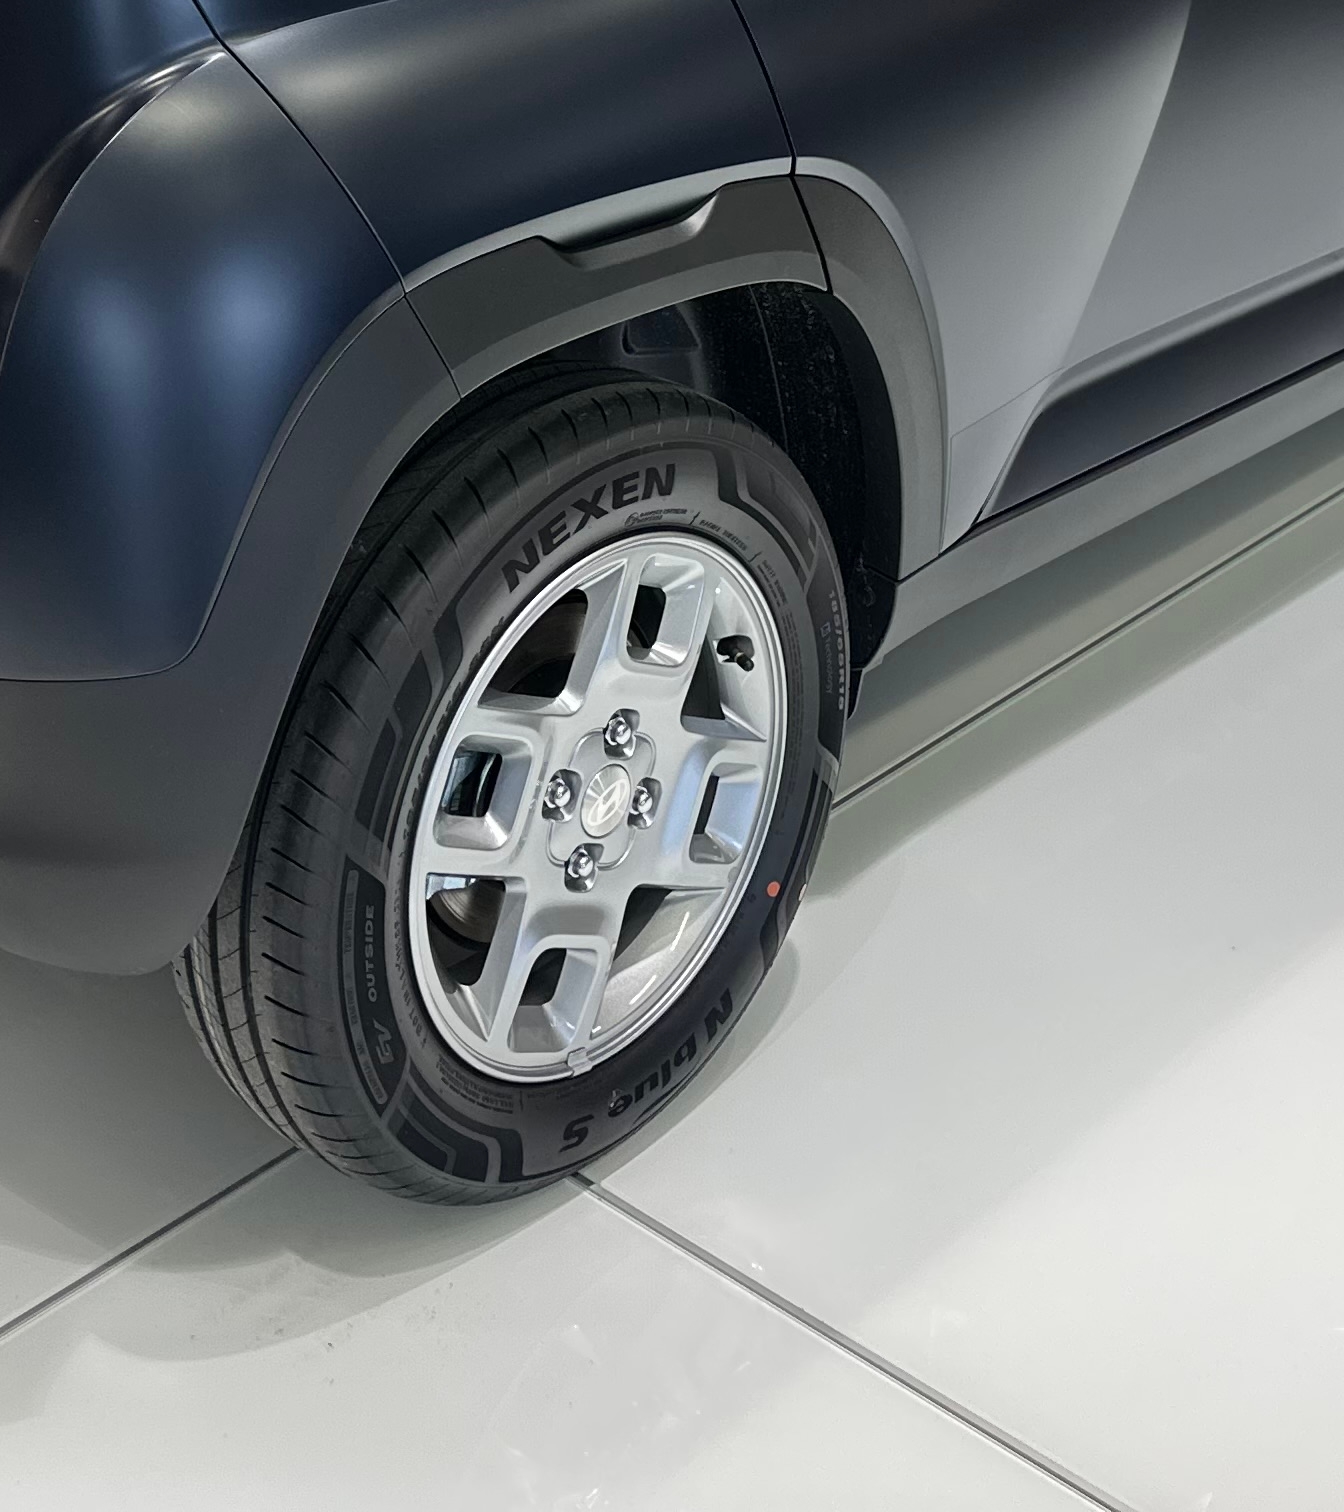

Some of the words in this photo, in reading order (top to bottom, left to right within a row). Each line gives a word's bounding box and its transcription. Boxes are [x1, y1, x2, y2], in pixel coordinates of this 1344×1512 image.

[501, 463, 676, 593] NEXEN
[364, 904, 378, 1003] OUTSIDE
[705, 988, 733, 1043] N
[608, 1032, 697, 1118] blue
[559, 1114, 594, 1154] S
